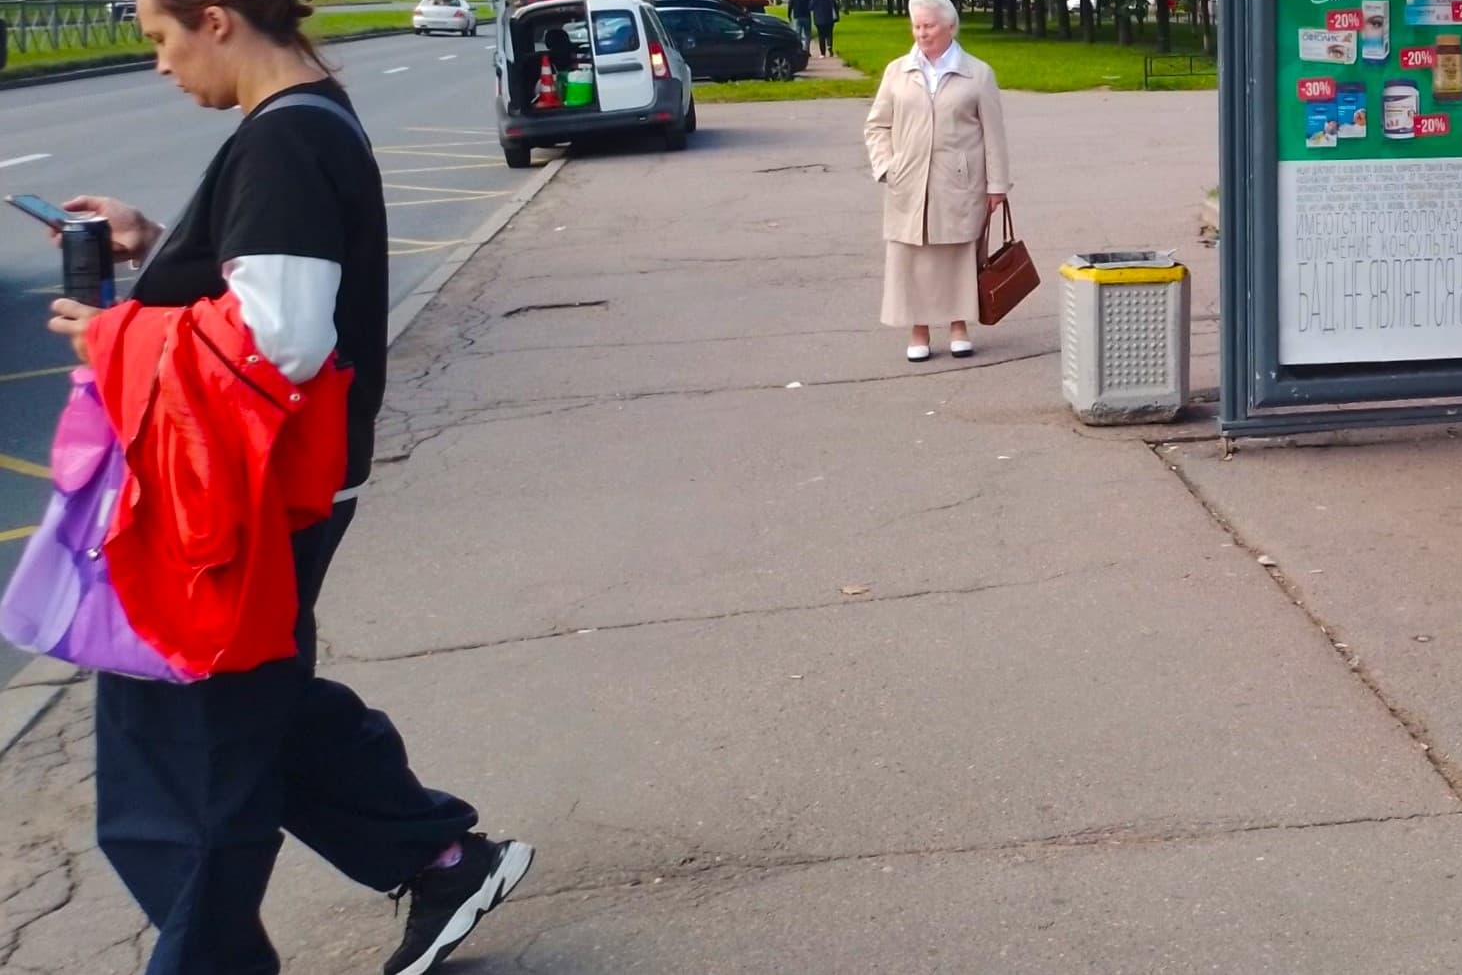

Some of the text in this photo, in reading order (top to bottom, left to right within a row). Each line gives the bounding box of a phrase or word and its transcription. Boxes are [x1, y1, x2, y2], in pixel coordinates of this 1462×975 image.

[1329, 13, 1360, 28] -20%
[1403, 51, 1433, 66] -20%
[1300, 81, 1331, 97] -30%
[1416, 118, 1446, 133] -20%
[1296, 211, 1357, 236] ИМЕЮТСЯ
[1296, 234, 1372, 261] ПОЛУЧЕНИЕ
[1343, 259, 1364, 331] НЕ
[1369, 256, 1456, 329] ЯВЛЯЕТСЯ
